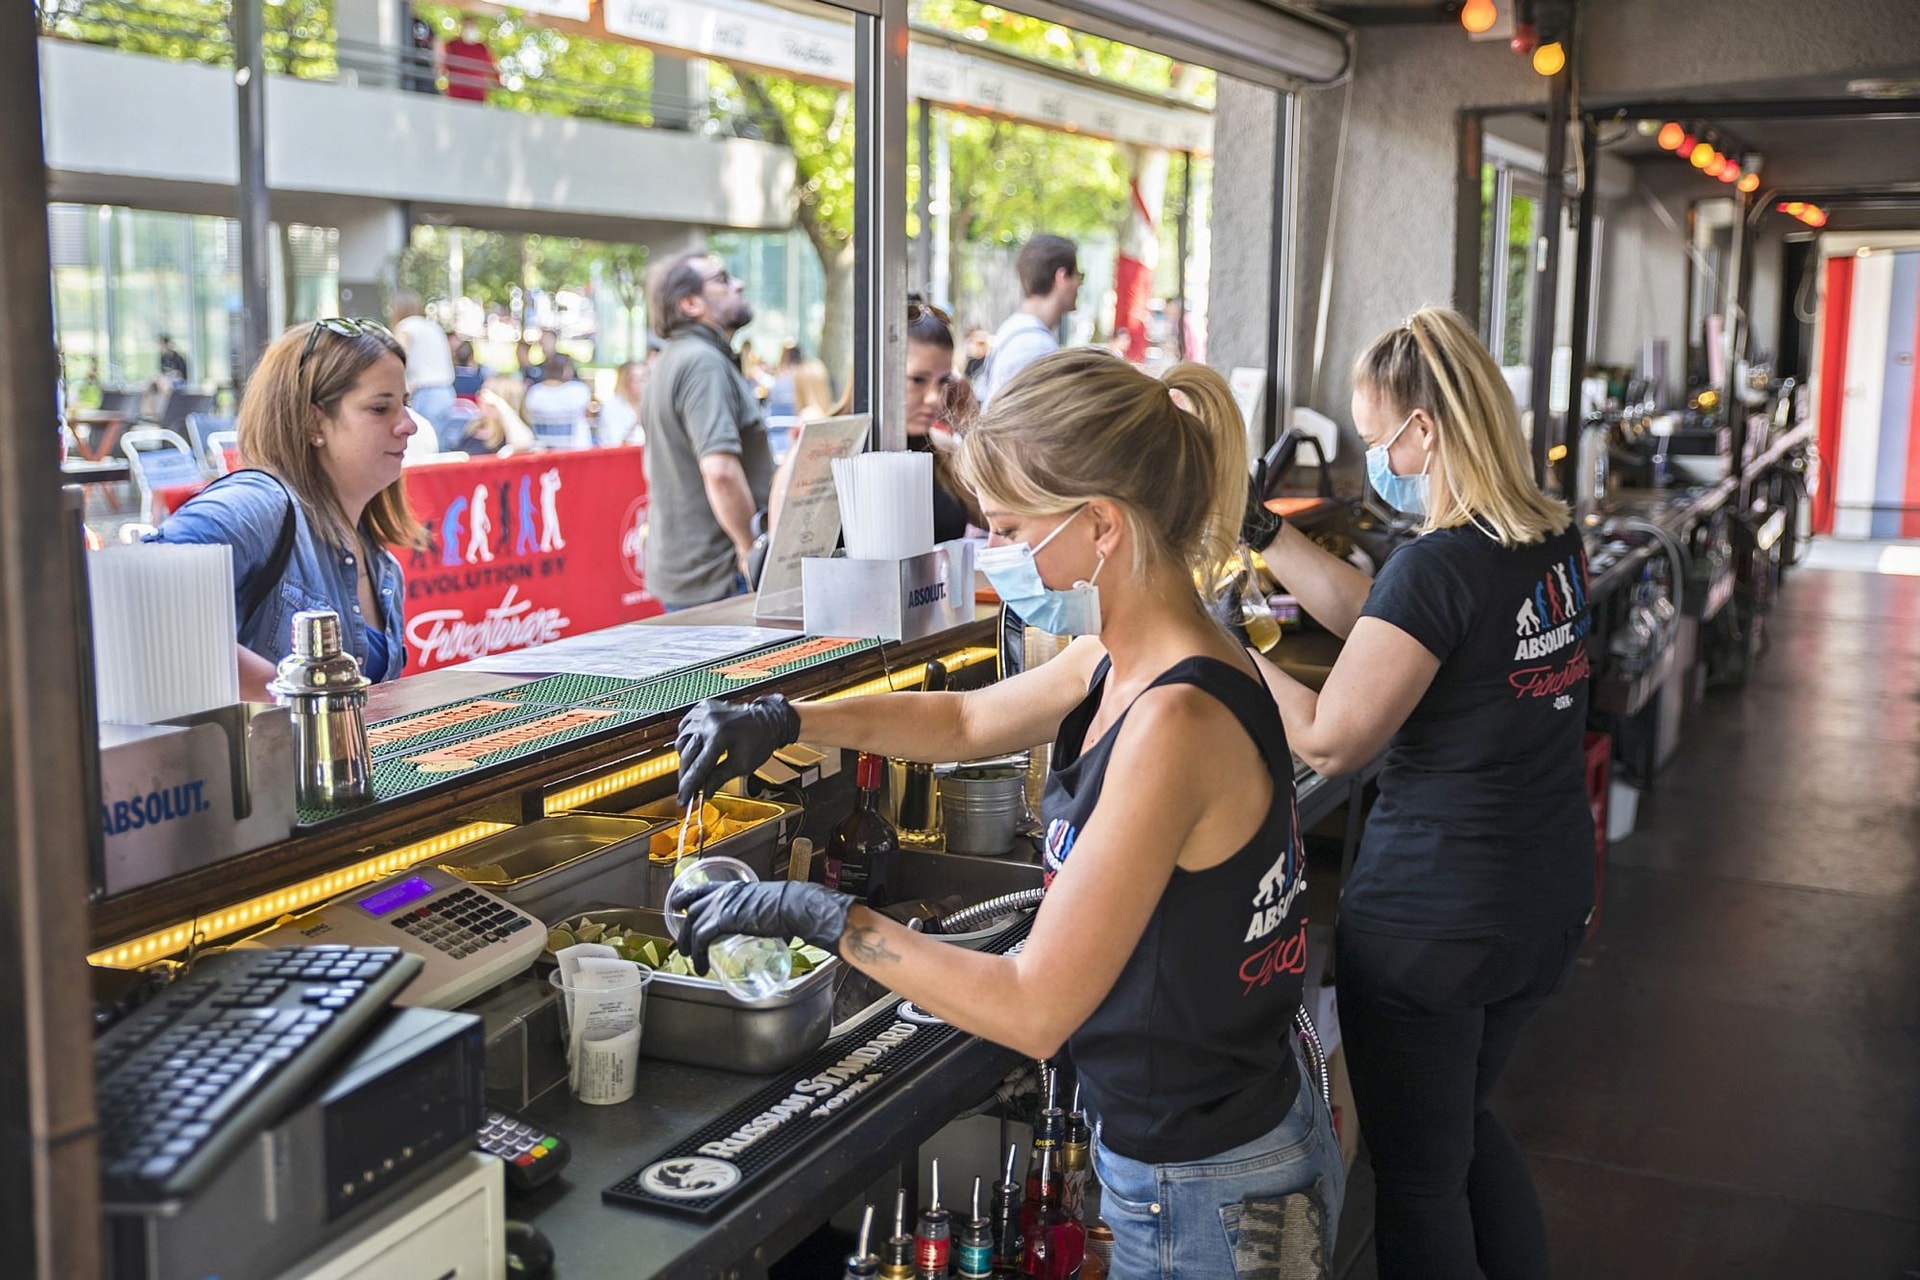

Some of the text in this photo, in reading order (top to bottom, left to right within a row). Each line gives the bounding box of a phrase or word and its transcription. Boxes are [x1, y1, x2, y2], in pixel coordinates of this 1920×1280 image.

[408, 562, 532, 598] EVOLUTION
[908, 582, 946, 609] ABSOLUT.
[1514, 622, 1575, 661] ABSOLUT.
[698, 1021, 918, 1158] RUSSIAN STANDARD
